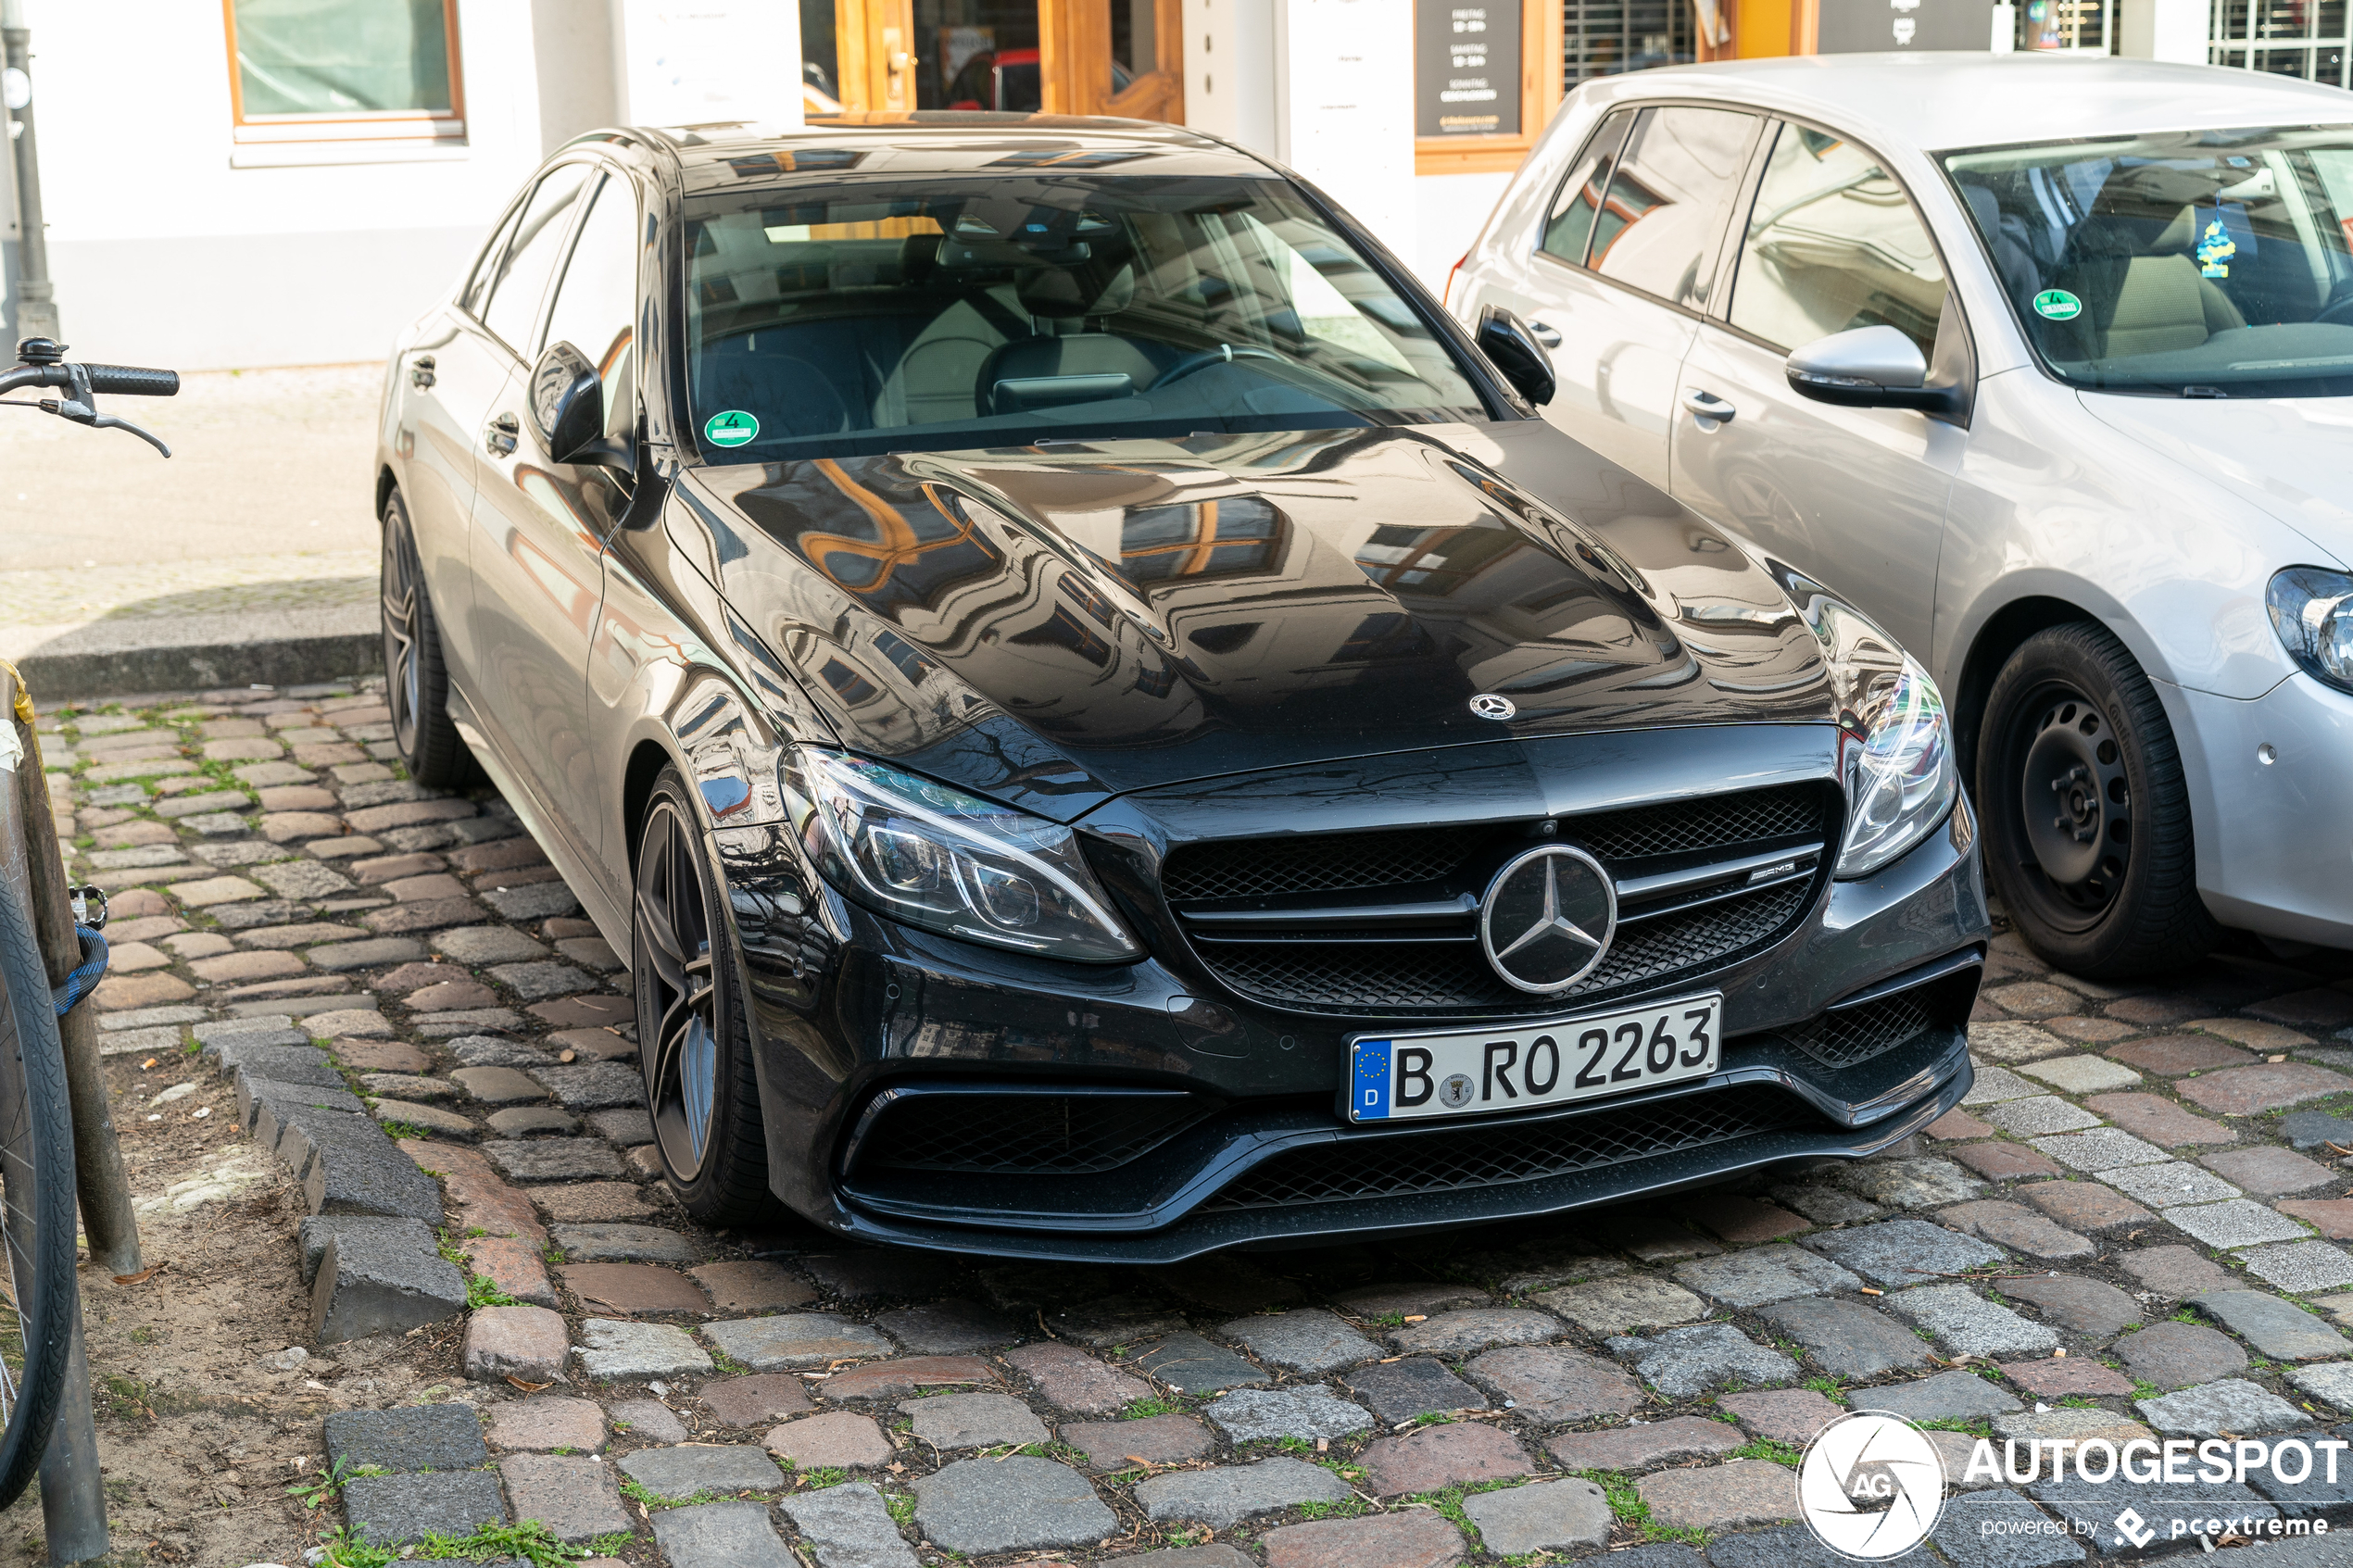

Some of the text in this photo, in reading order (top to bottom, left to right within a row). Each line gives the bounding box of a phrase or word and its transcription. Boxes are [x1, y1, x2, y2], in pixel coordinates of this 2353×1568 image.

[1452, 8, 1487, 20] FREITAG
[1450, 43, 1489, 56] SAMSTAG
[1449, 78, 1489, 90] SONNTAG
[724, 413, 740, 429] 4
[706, 858, 725, 952] ContiWinterContact
[1394, 1007, 1712, 1107] B RO 2263
[1365, 1088, 1378, 1106] D
